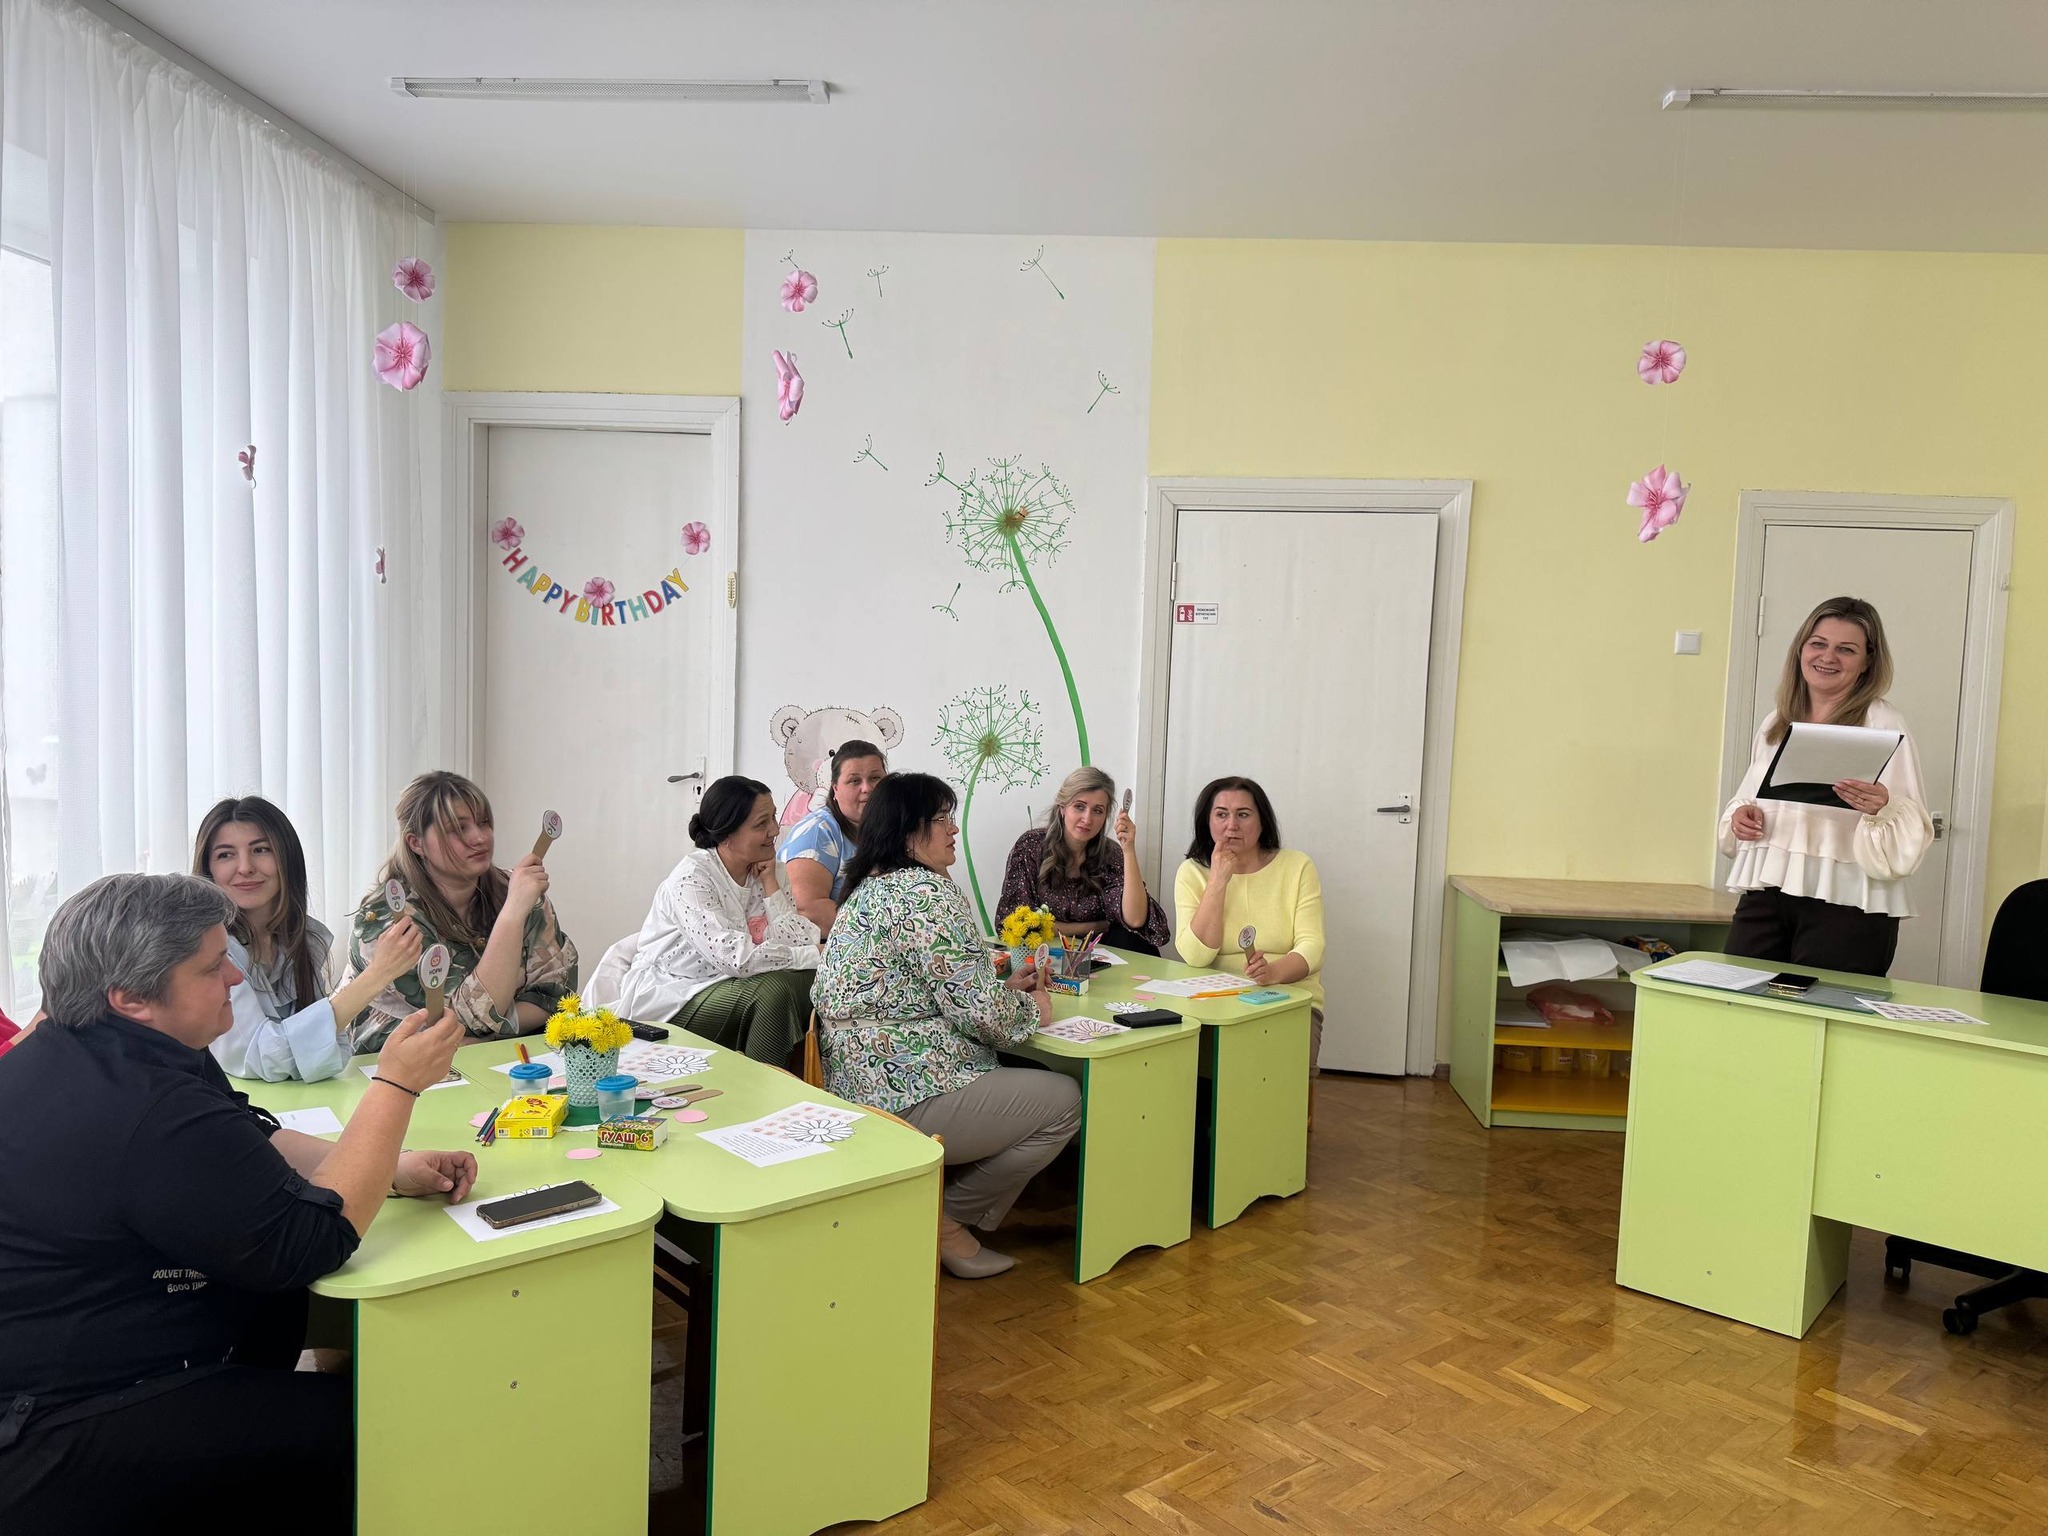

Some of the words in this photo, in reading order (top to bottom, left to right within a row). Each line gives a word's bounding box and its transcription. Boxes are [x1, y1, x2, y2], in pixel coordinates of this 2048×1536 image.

[502, 547, 578, 614] HAPPY
[575, 567, 690, 626] BIRTHDAY
[1050, 981, 1070, 992] УАШ
[600, 1130, 637, 1144] ГУАШ
[640, 1133, 650, 1143] 6
